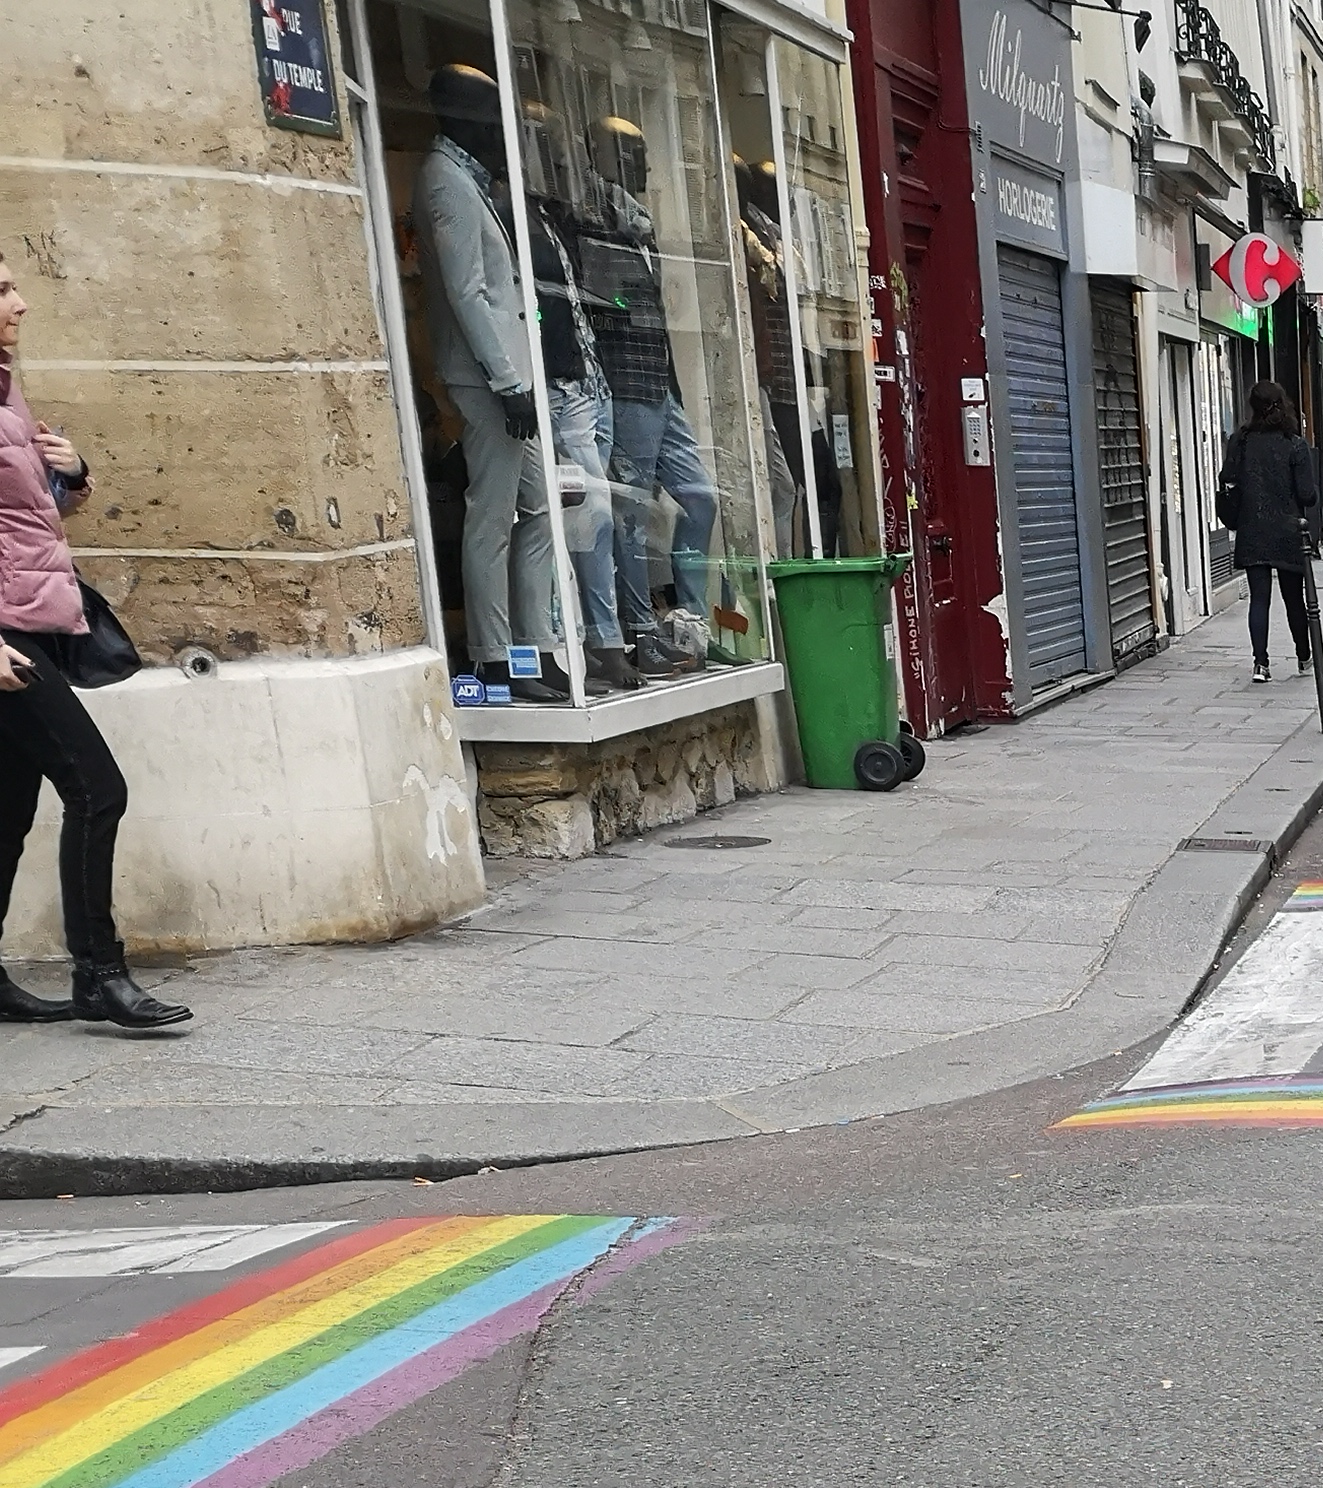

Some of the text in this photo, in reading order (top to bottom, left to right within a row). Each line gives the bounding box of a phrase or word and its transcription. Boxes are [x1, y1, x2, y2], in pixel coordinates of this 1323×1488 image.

[272, 59, 325, 93] DU TEMPLE
[997, 177, 1057, 231] HORLOGERIE
[456, 684, 479, 697] ADT
